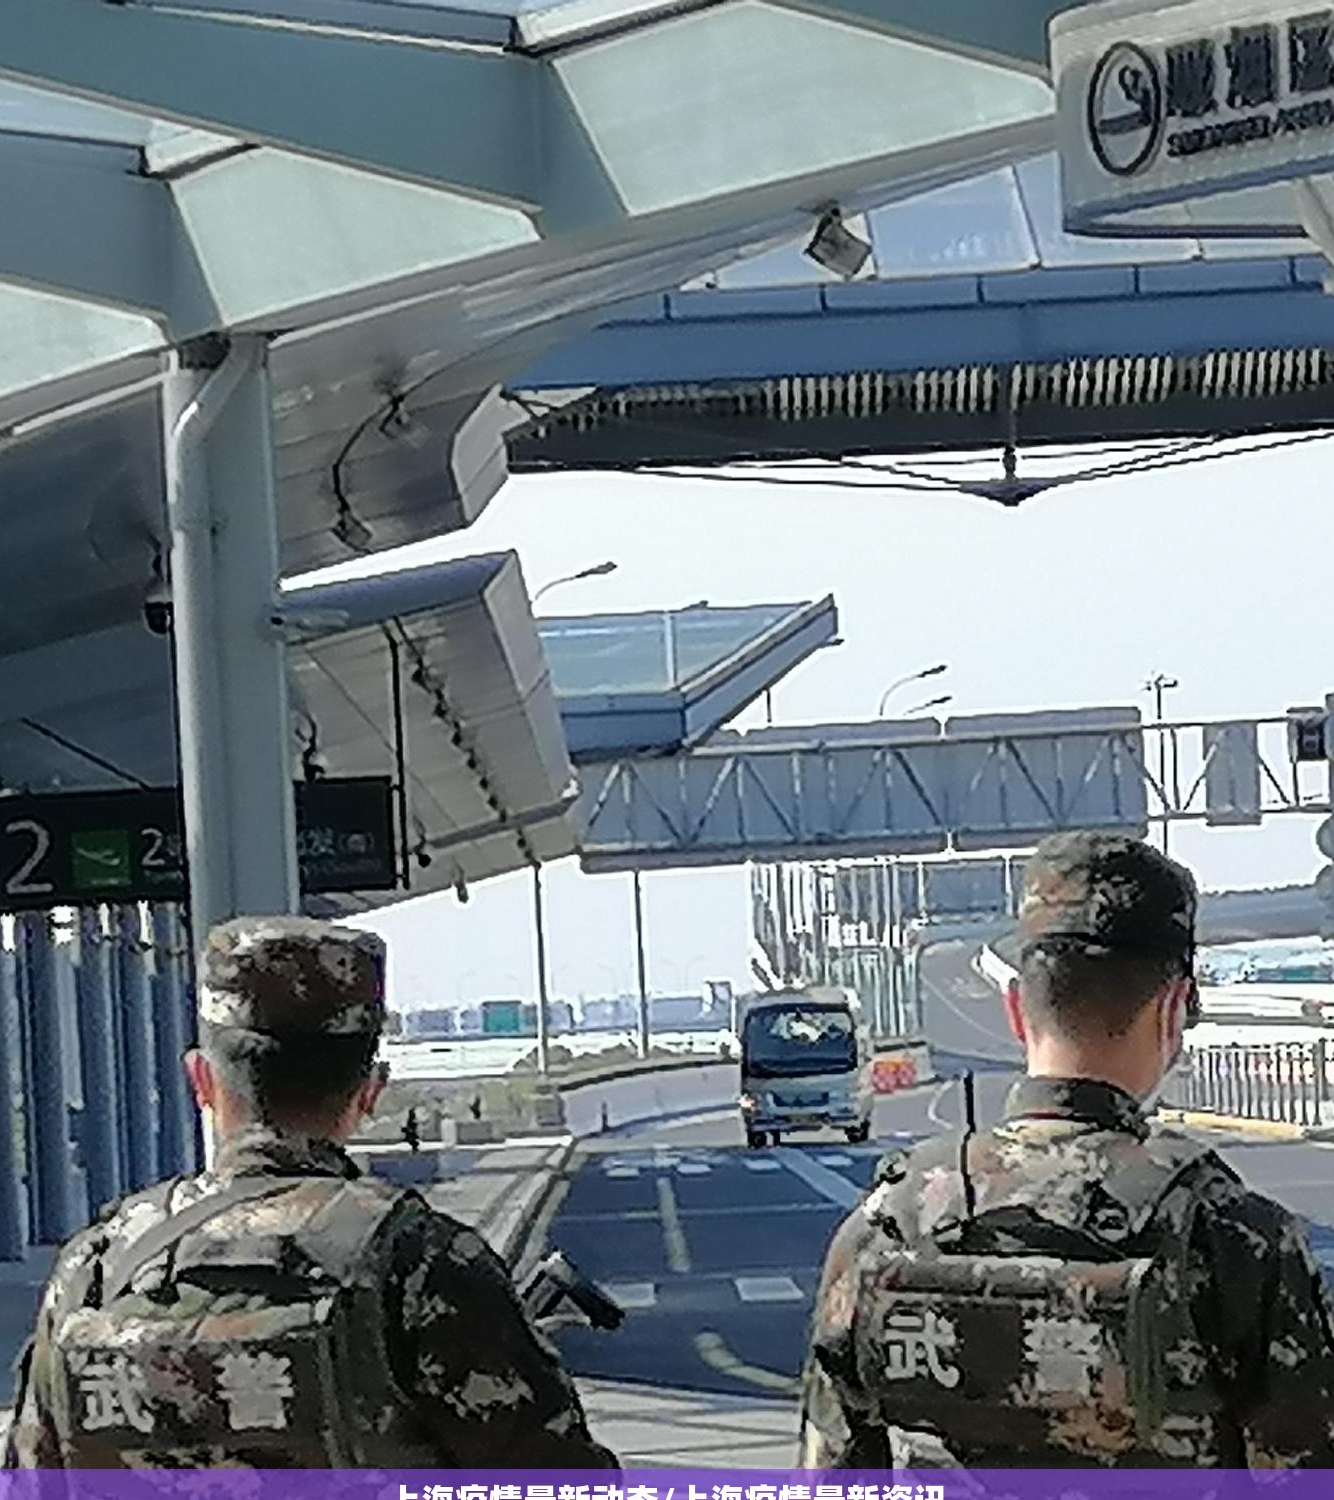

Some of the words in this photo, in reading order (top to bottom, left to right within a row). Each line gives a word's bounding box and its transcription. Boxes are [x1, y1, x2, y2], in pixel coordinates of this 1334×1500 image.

[5, 819, 54, 894] 2
[78, 1350, 295, 1434] 武警
[883, 1310, 1102, 1394] 武警
